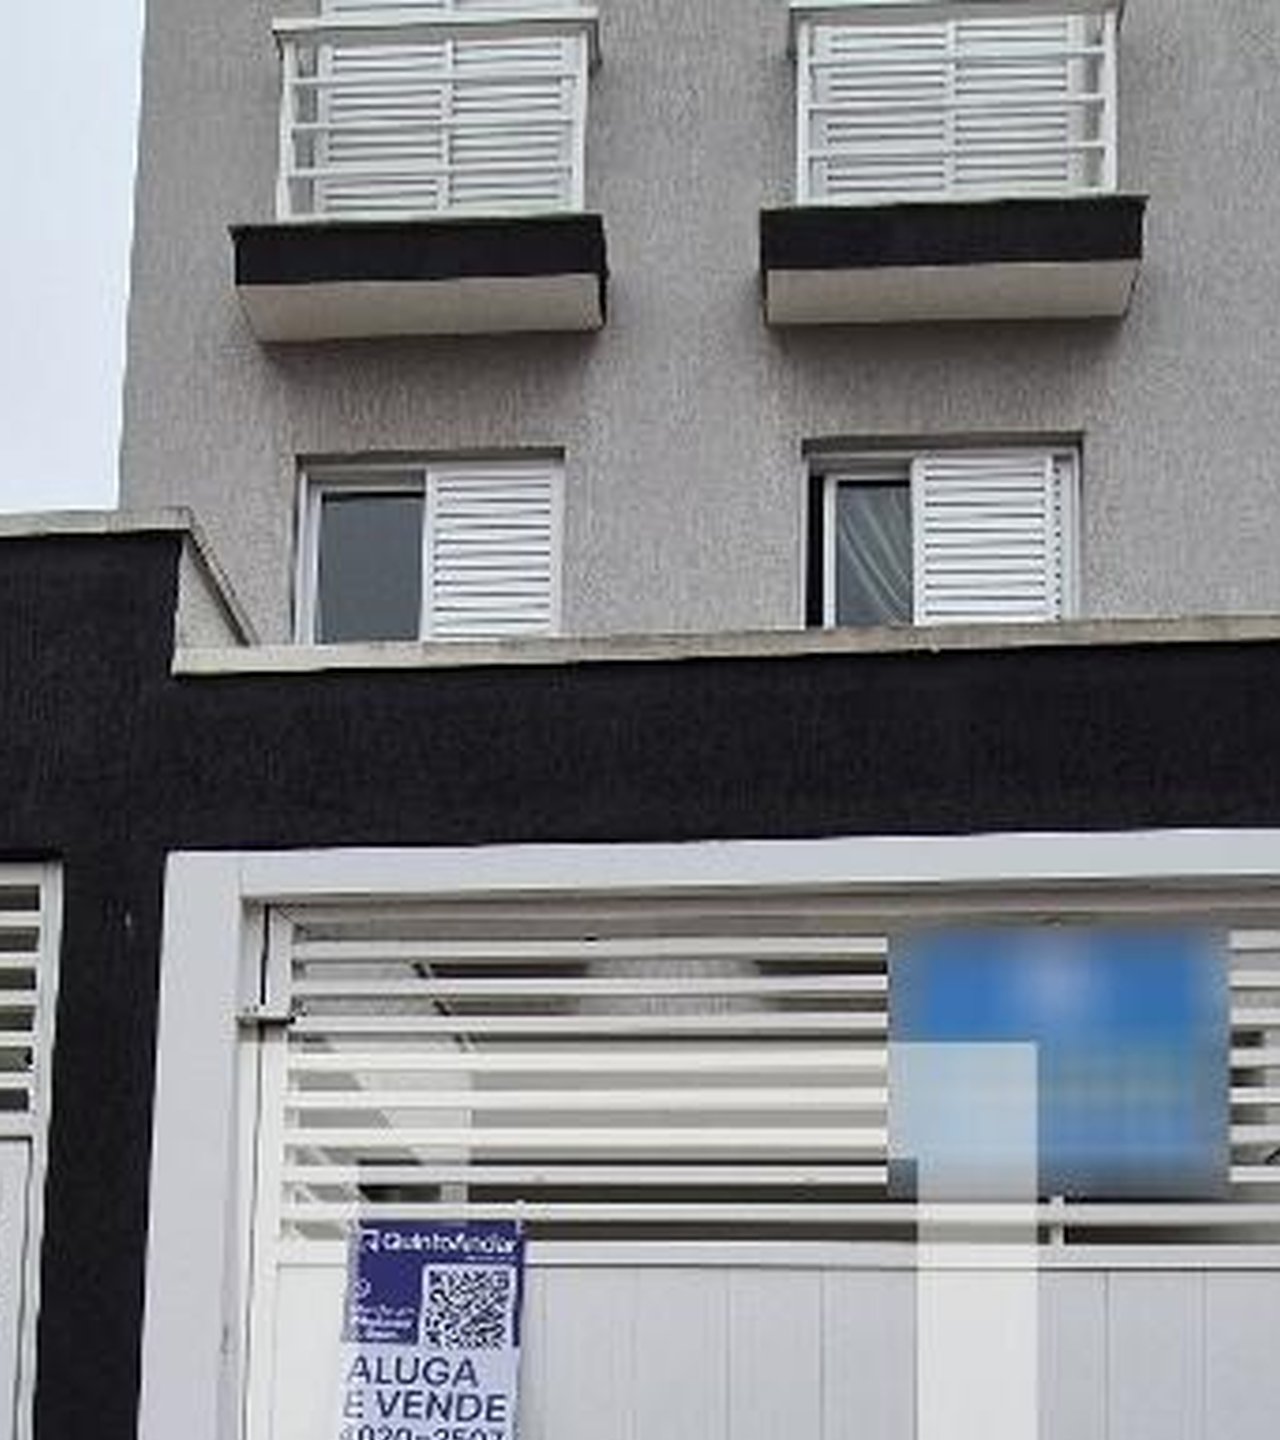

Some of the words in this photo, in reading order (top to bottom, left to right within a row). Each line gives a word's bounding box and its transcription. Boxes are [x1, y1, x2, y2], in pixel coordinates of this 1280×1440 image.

[348, 1356, 479, 1388] ALUGA
[343, 1390, 364, 1419] E
[376, 1390, 507, 1423] VENDE
